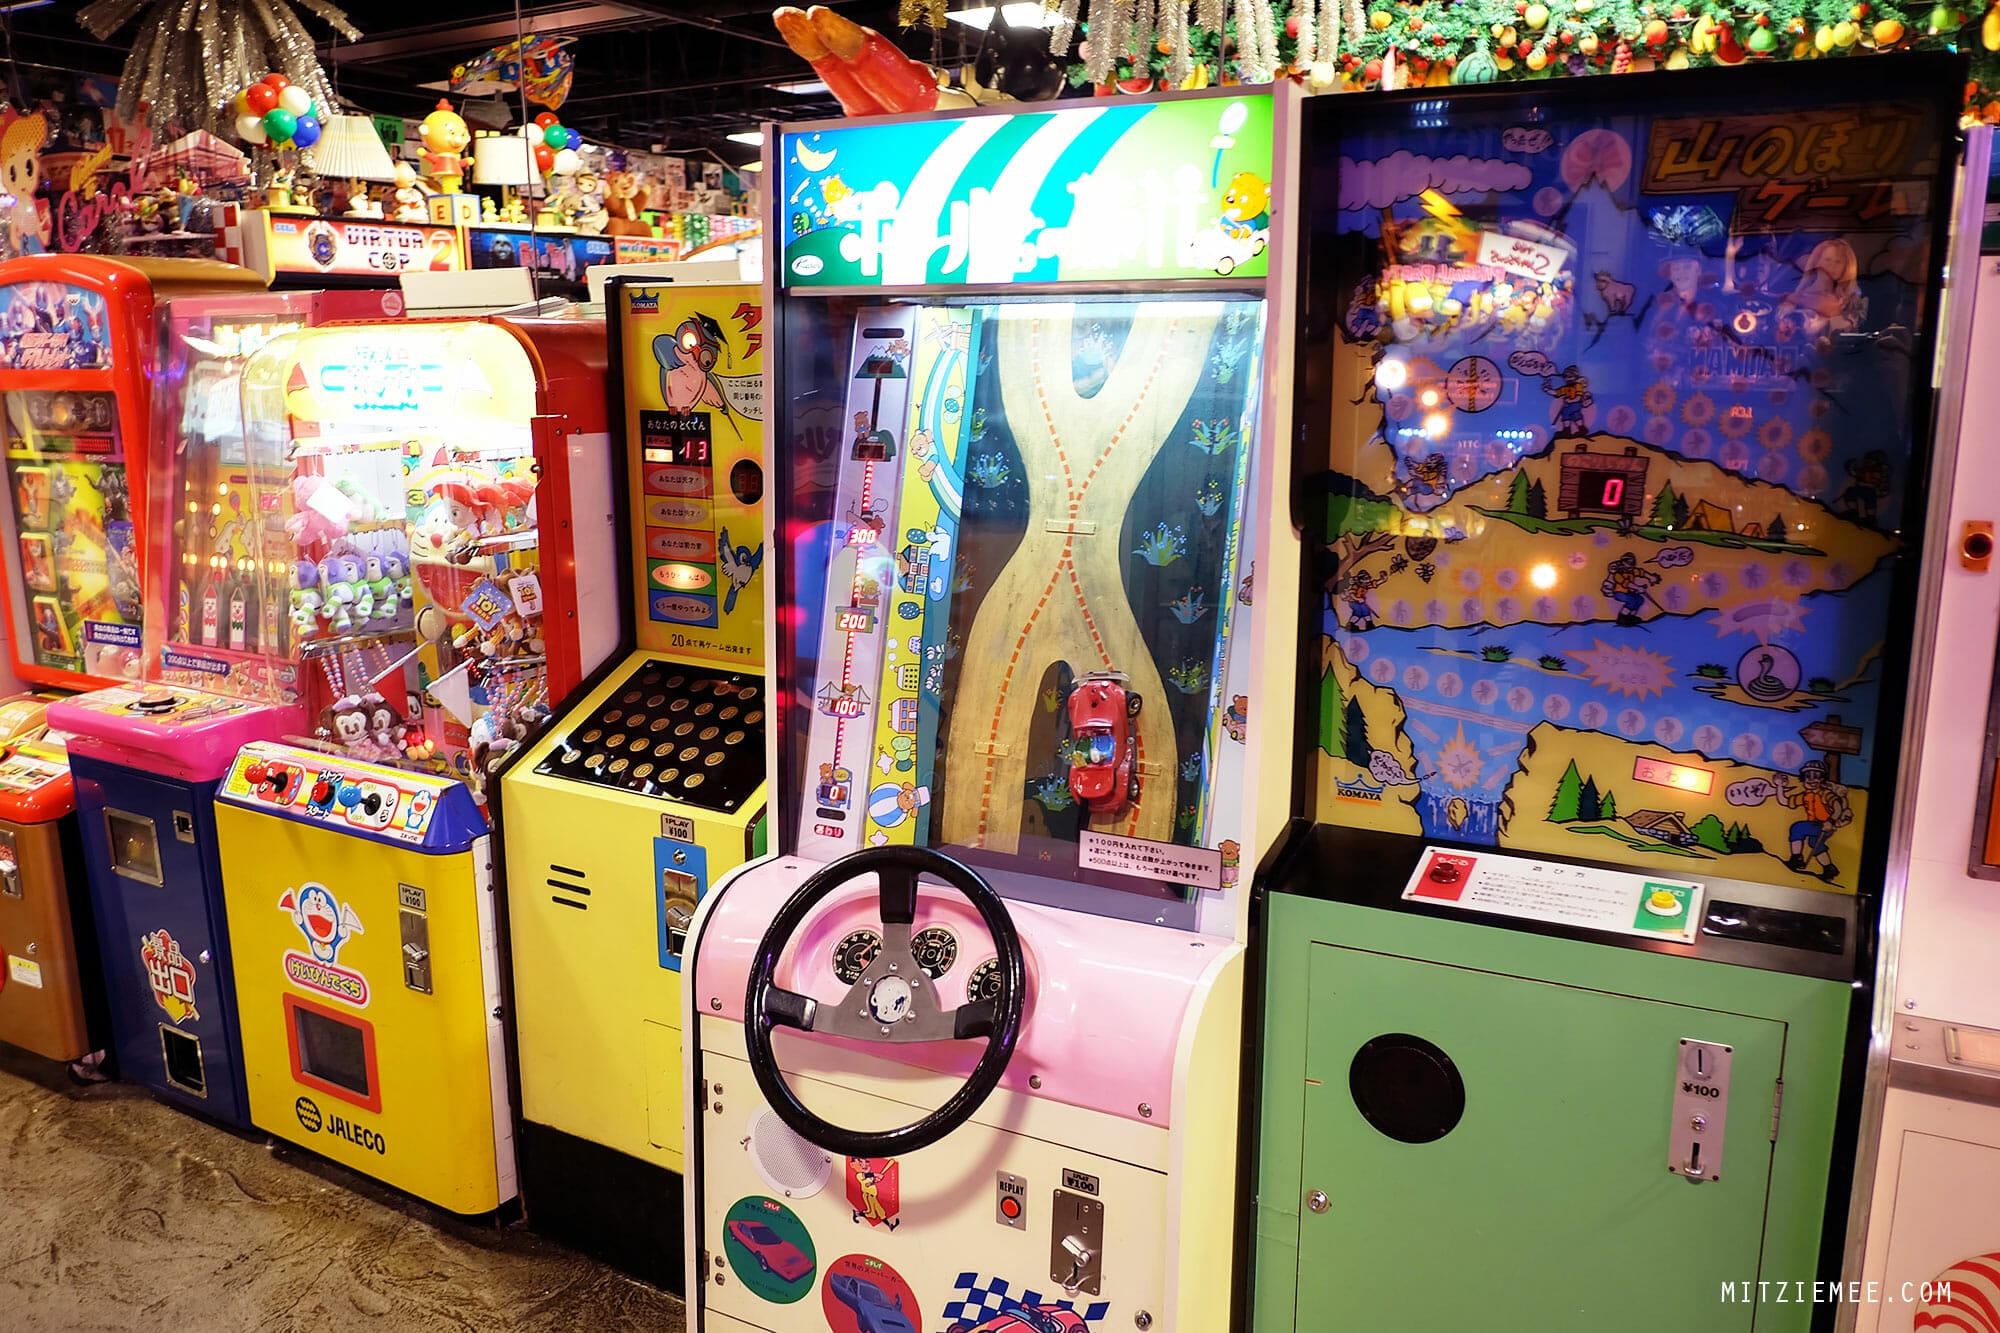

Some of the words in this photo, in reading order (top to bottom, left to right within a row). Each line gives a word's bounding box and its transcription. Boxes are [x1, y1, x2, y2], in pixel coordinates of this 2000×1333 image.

[1655, 119, 1909, 181] 山のぼり
[437, 205, 446, 220] E
[462, 205, 472, 220] D
[346, 226, 424, 249] VIRTUA
[368, 251, 411, 270] COP
[733, 392, 763, 401] 同じ番号の
[685, 440, 708, 461] 13
[1601, 478, 1625, 507] 0
[850, 528, 877, 545] 300
[476, 591, 502, 616] TOY
[840, 612, 868, 630] 200
[834, 699, 858, 716] 100
[318, 769, 345, 782] ストップ
[828, 786, 839, 800] 0
[1337, 788, 1382, 801] KOMAYA
[304, 805, 330, 820] スタート
[669, 826, 688, 839] ¥100
[815, 826, 843, 838] おわり
[405, 895, 422, 908] ¥100
[150, 931, 183, 968] 景品
[149, 958, 194, 1004] 出口
[1682, 1082, 1720, 1098] ¥100
[326, 1113, 386, 1155] JALECO
[999, 1181, 1025, 1196] REPLAY
[1066, 1176, 1095, 1192] ¥100
